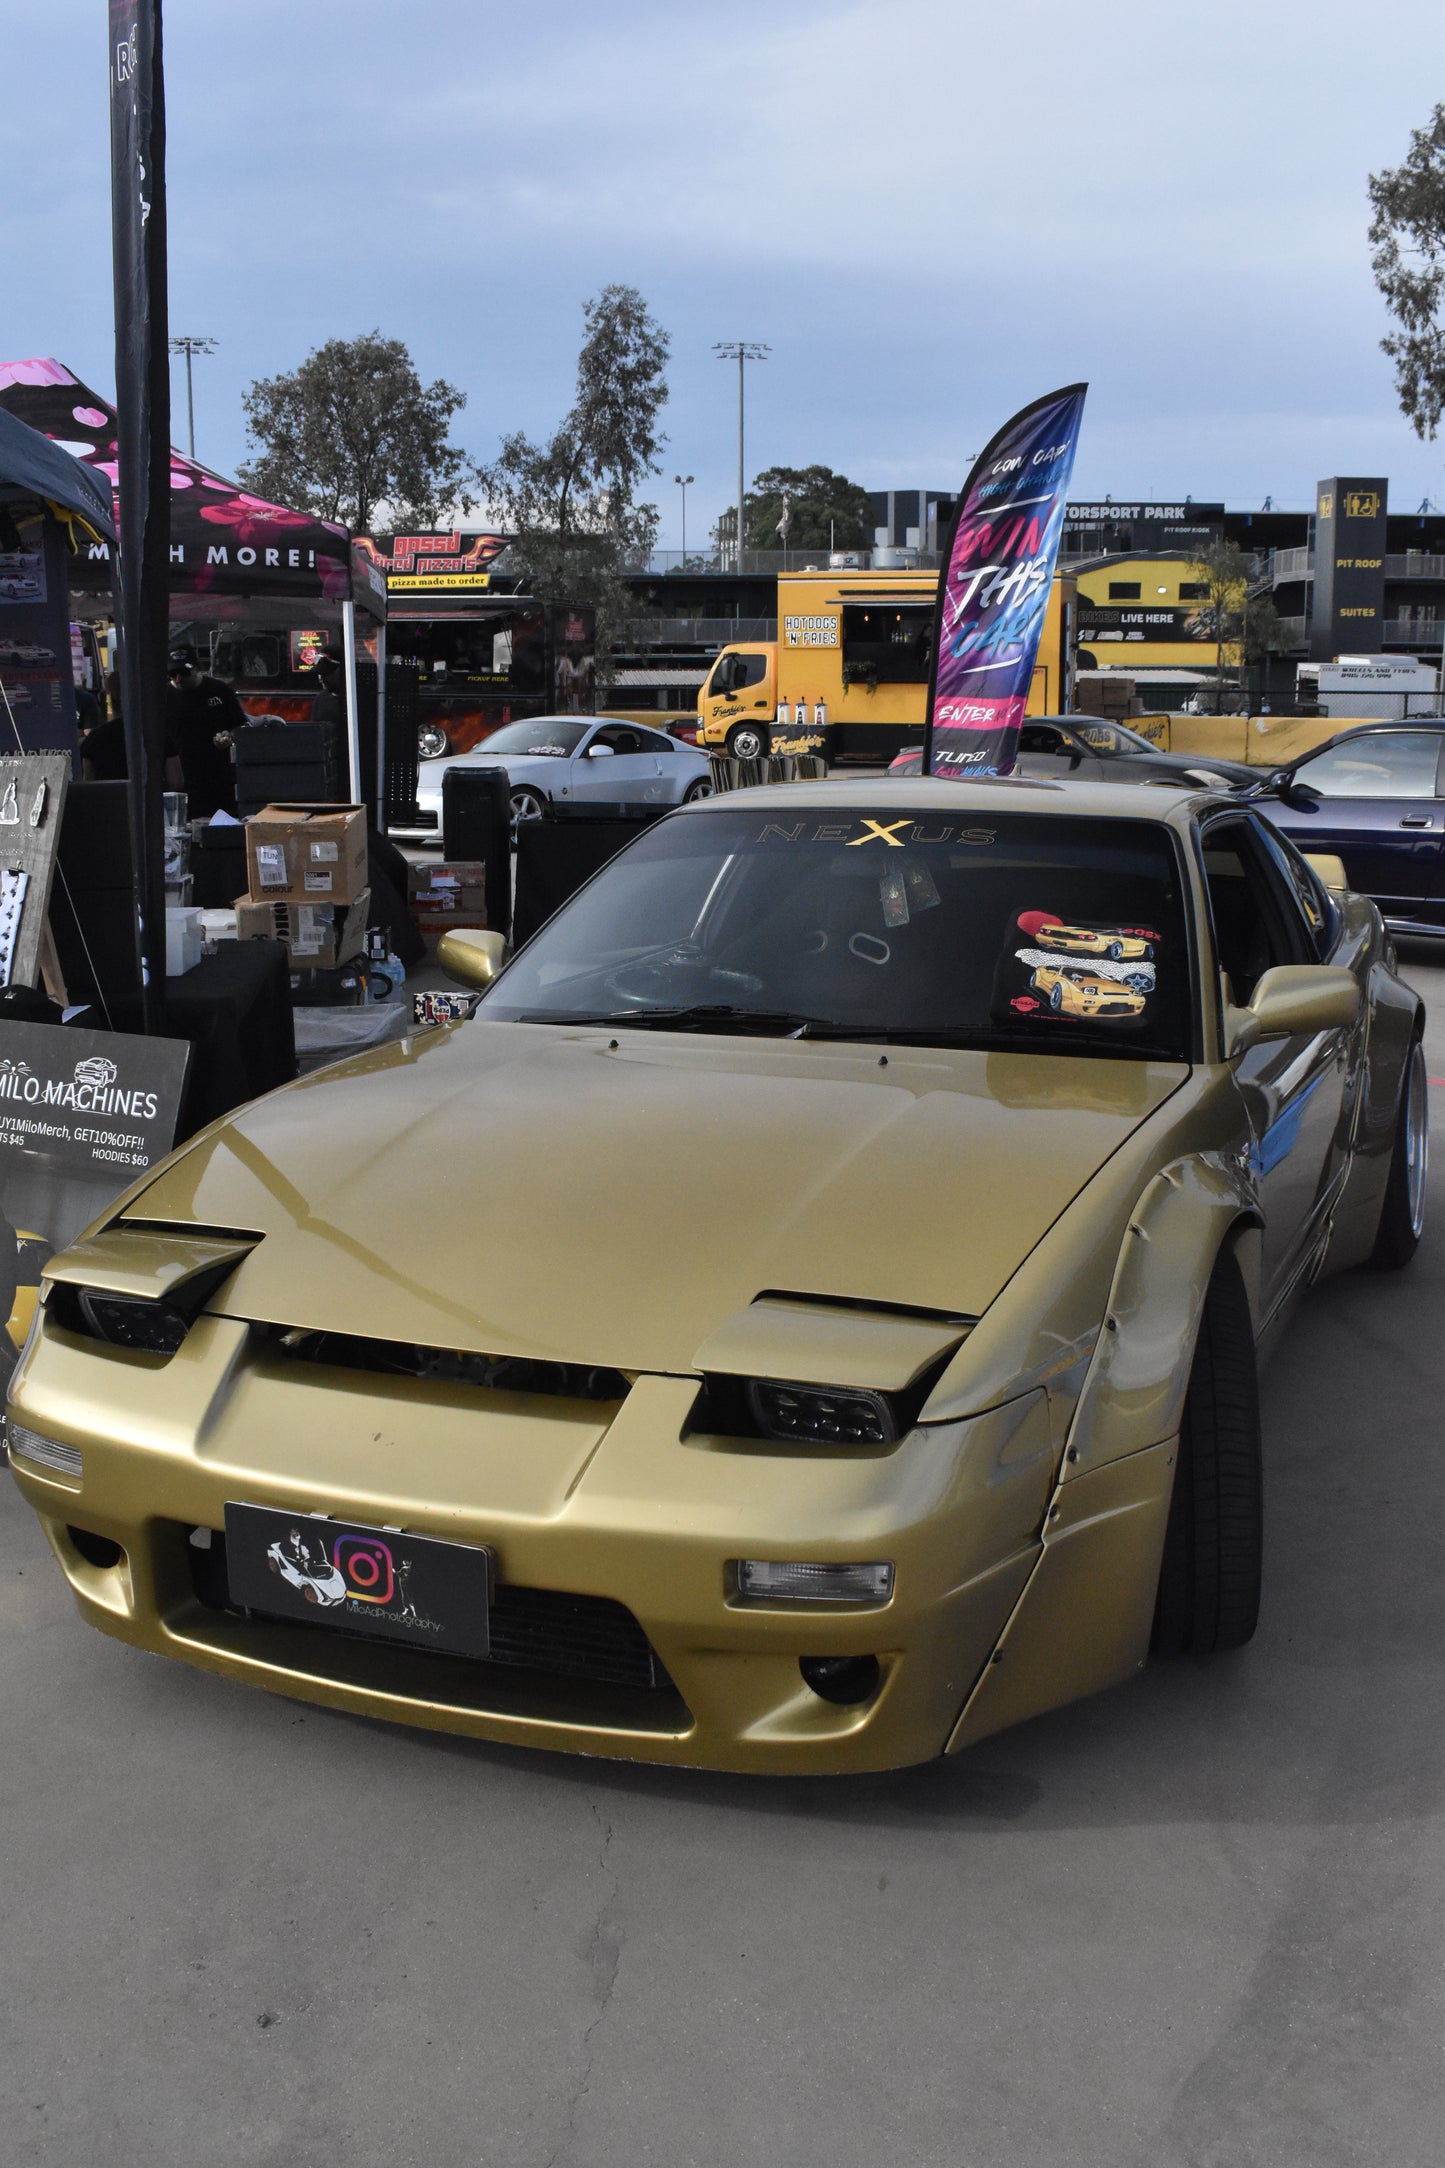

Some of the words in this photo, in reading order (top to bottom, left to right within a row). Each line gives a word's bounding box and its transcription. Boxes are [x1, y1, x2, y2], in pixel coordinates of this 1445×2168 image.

[1144, 506, 1186, 519] PARK
[959, 504, 1055, 563] WIN
[207, 545, 316, 569] MORE!
[1337, 560, 1353, 568] PIT
[1355, 560, 1382, 568] ROOF
[392, 578, 416, 588] pizza
[418, 577, 444, 586] made
[459, 576, 485, 585] order
[1121, 614, 1144, 623] LIVE
[1146, 614, 1174, 623] HERE
[1340, 608, 1376, 617] SUITES
[785, 616, 838, 631] HOTDOGS
[803, 632, 837, 646] FRIES
[938, 704, 996, 726] ENTER
[756, 819, 998, 847] NEXUS
[45, 1080, 158, 1119] MACHINES
[9, 1132, 25, 1146] $45
[74, 1127, 145, 1150] GET10%OFF!!
[92, 1148, 130, 1164] HOODIES
[131, 1154, 149, 1167] $60
